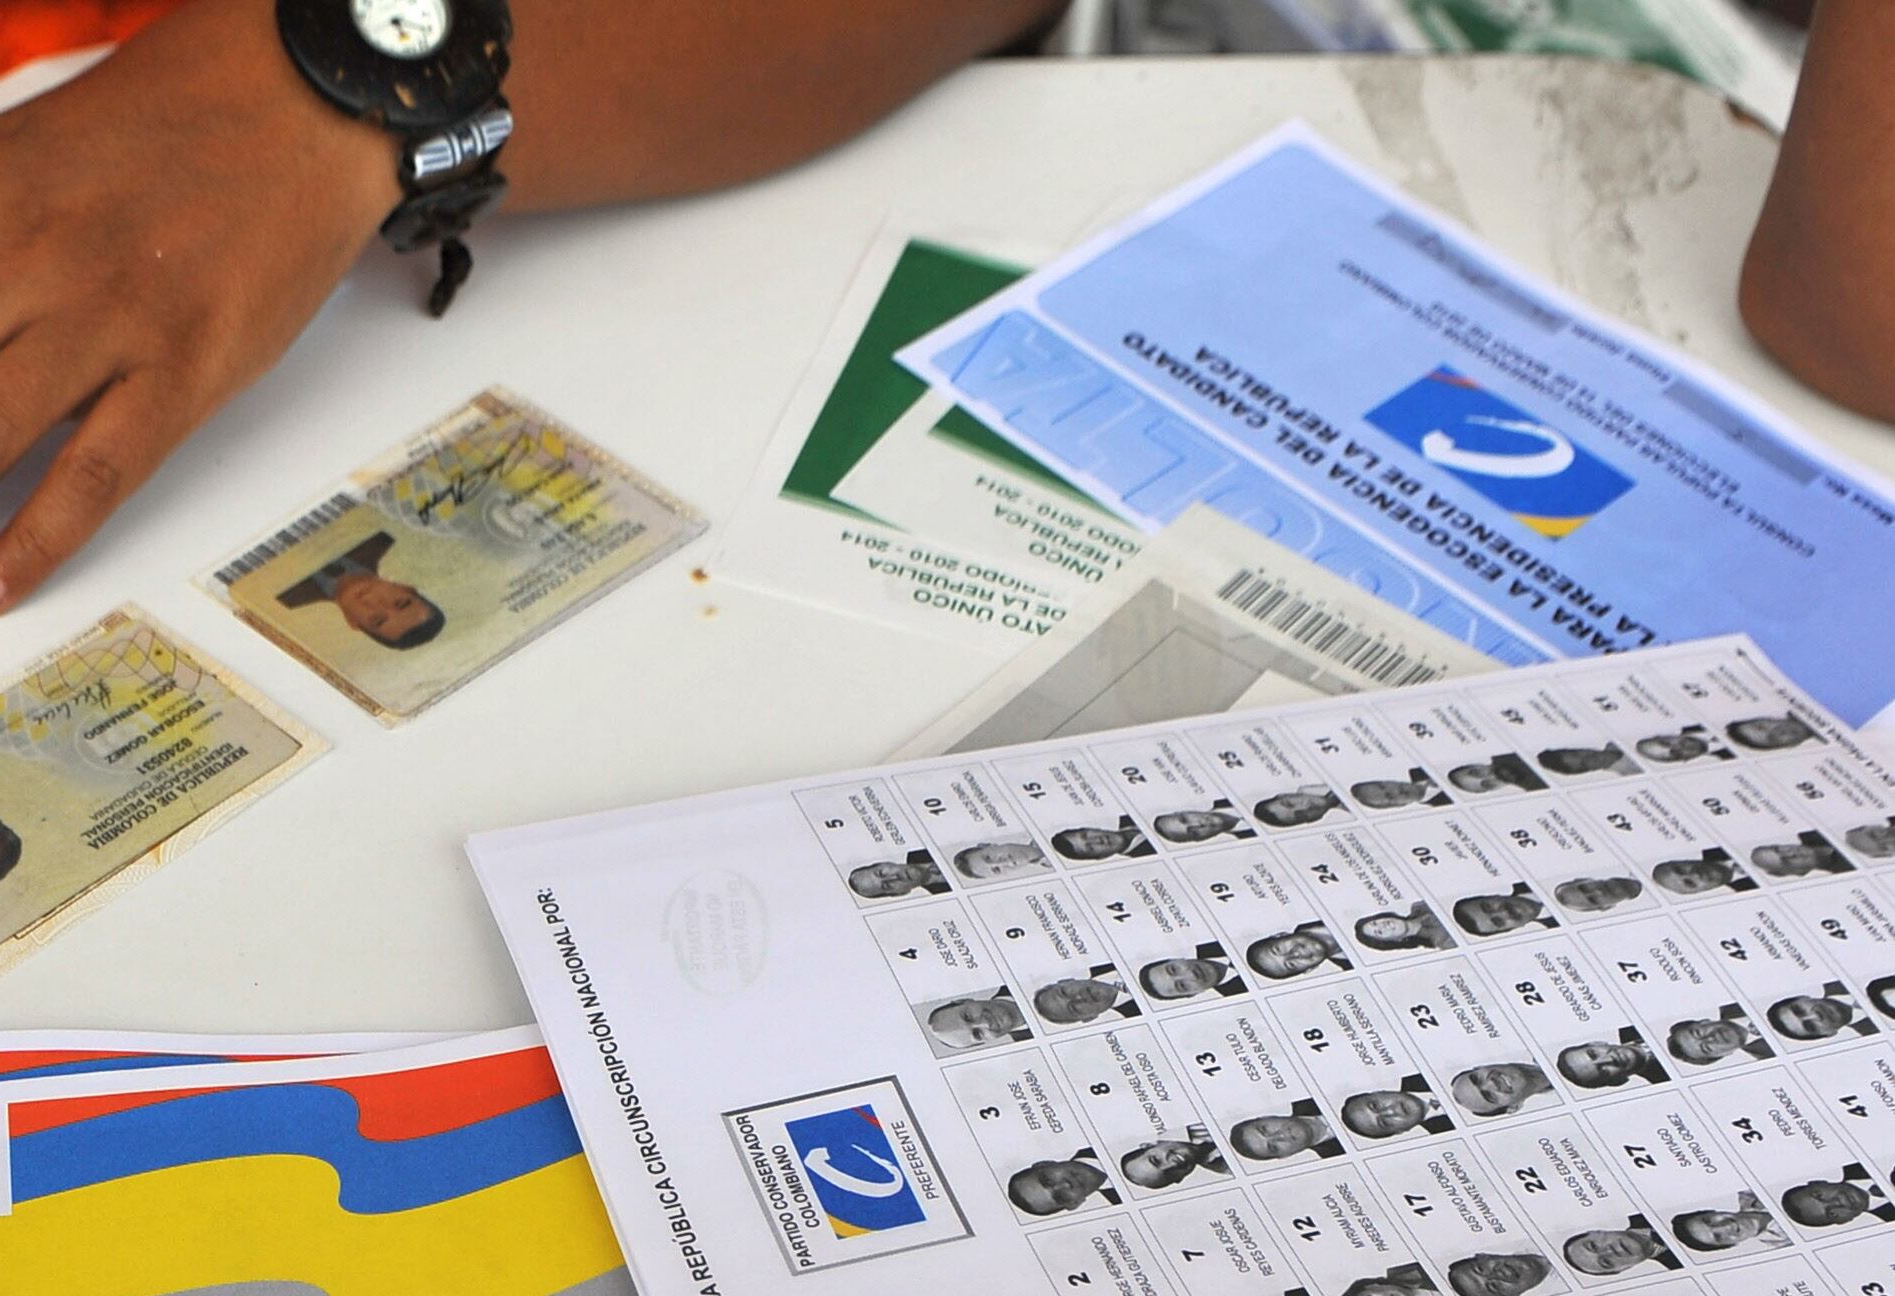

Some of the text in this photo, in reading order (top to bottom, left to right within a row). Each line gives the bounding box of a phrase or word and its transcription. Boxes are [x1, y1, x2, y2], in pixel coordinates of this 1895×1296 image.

[841, 531, 959, 572] 2010 2014
[868, 556, 1067, 622] DE LA REPÚBLICA
[79, 797, 144, 841] PERSONAL
[85, 744, 249, 852] REPUBLICA DE COLOMBIA
[536, 887, 565, 925] POR:
[552, 924, 601, 1009] NACIONAL
[1194, 1050, 1222, 1077] 13
[1224, 1032, 1262, 1082] CESAR TULIO
[1235, 1016, 1288, 1090] DELGADO BLANDON
[585, 1010, 667, 1175] CIRCUNSCRIPCIÓN
[977, 1105, 1001, 1120] 3
[1006, 1079, 1042, 1131] EFRAIN JOSE
[1021, 1067, 1064, 1134] CEPEDA SARABIA
[770, 1143, 821, 1228] COLOMBIANO
[889, 1119, 940, 1200] PREFERENTE
[734, 1113, 816, 1268] PARTIDO CONSERVADOR
[653, 1175, 714, 1282] REPÚBLICA
[1105, 1226, 1141, 1272] GUTIERREZ
[1180, 1248, 1205, 1263] 7
[1207, 1218, 1251, 1273] OSCAR JOSUE
[1222, 1207, 1275, 1277] REYES CARDENAS
[1066, 1270, 1092, 1287] 2
[1089, 1235, 1125, 1281] HERNANDO
